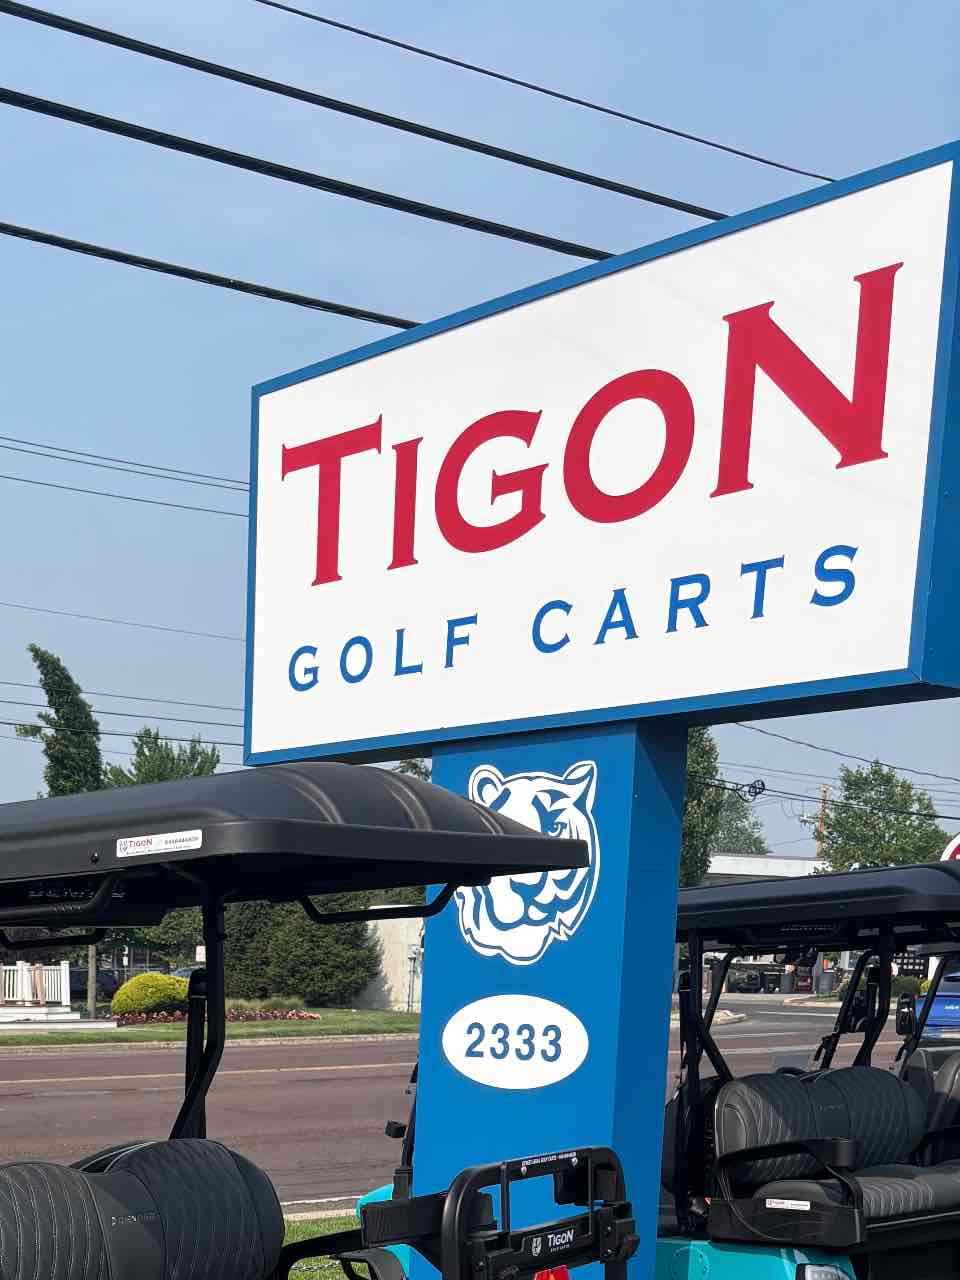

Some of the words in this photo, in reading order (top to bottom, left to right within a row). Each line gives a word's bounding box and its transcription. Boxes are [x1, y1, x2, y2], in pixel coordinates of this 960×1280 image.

[281, 262, 904, 586] TIGON
[288, 614, 478, 692] GOLF
[531, 544, 859, 654] CARTS
[465, 1021, 563, 1062] 2333
[547, 1229, 574, 1247] TIGON
